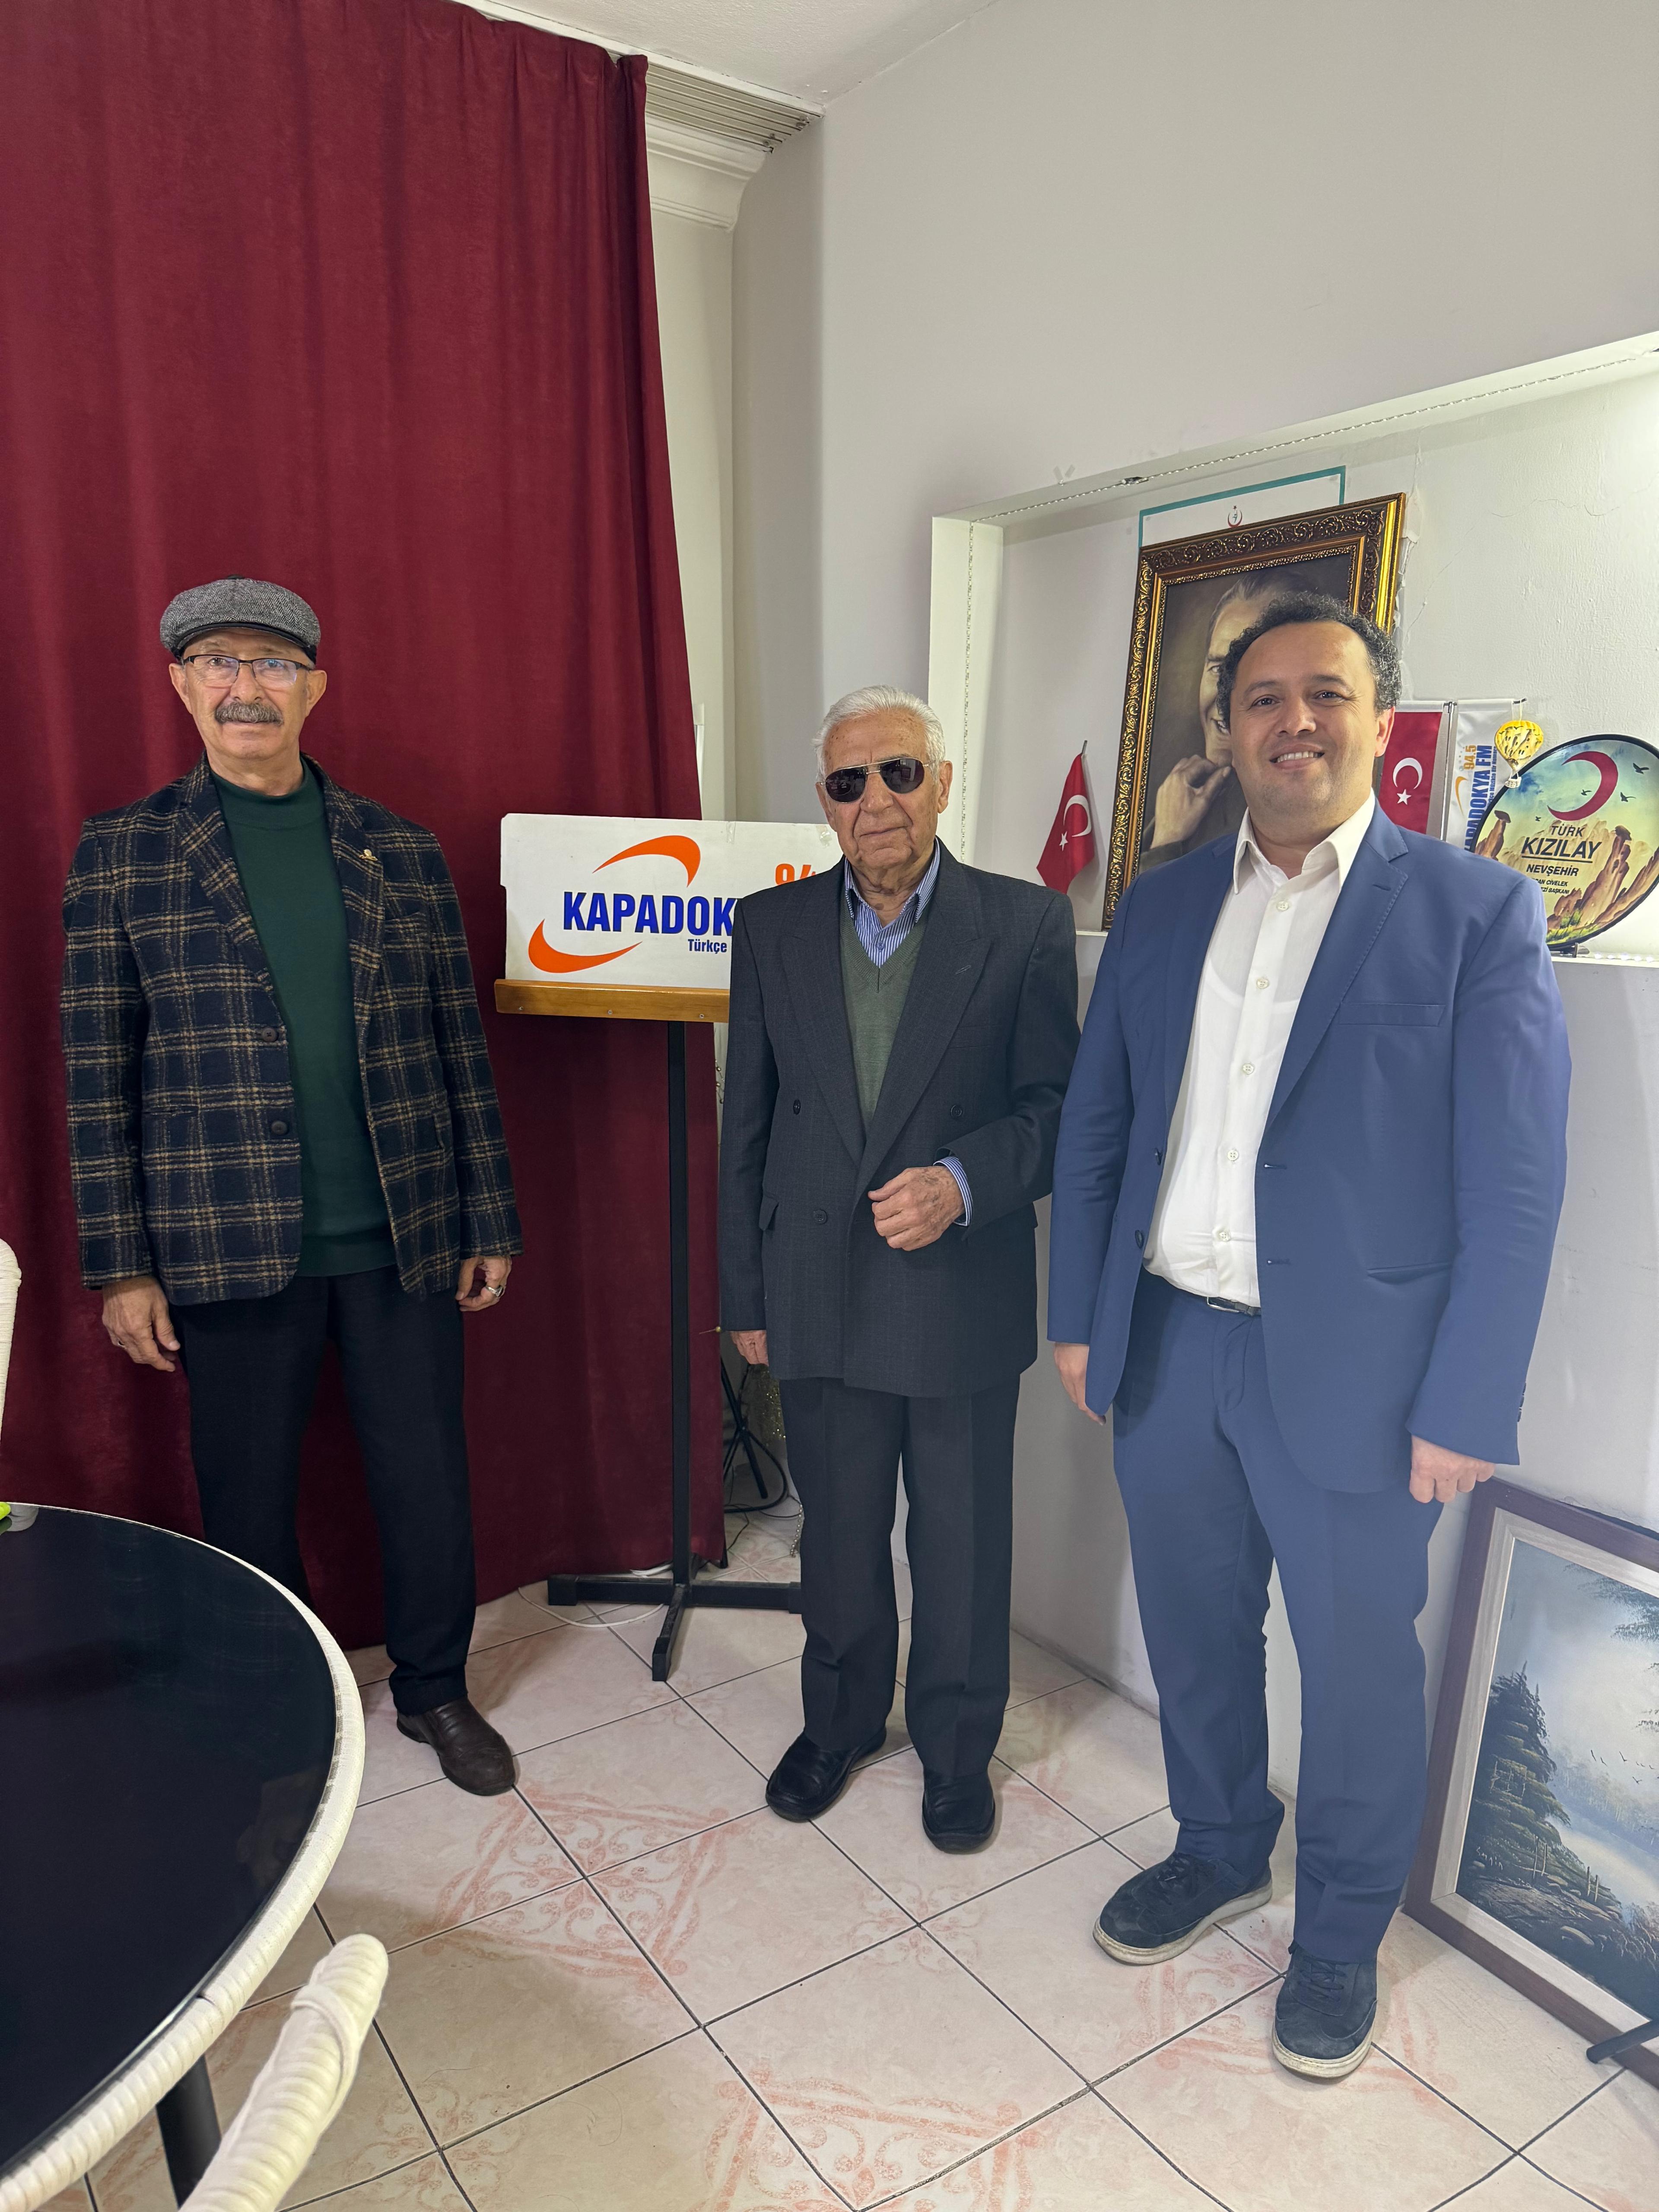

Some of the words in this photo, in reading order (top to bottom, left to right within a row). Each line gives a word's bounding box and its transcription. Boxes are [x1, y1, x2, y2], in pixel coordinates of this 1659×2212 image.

[1463, 745, 1477, 770] 94.5
[1475, 745, 1492, 766] FM
[1551, 823, 1585, 837] TÜRK
[1521, 837, 1602, 859] KIZILAY
[1526, 864, 1579, 877] NEVŞEHİR
[688, 939, 727, 954] Türkçe
